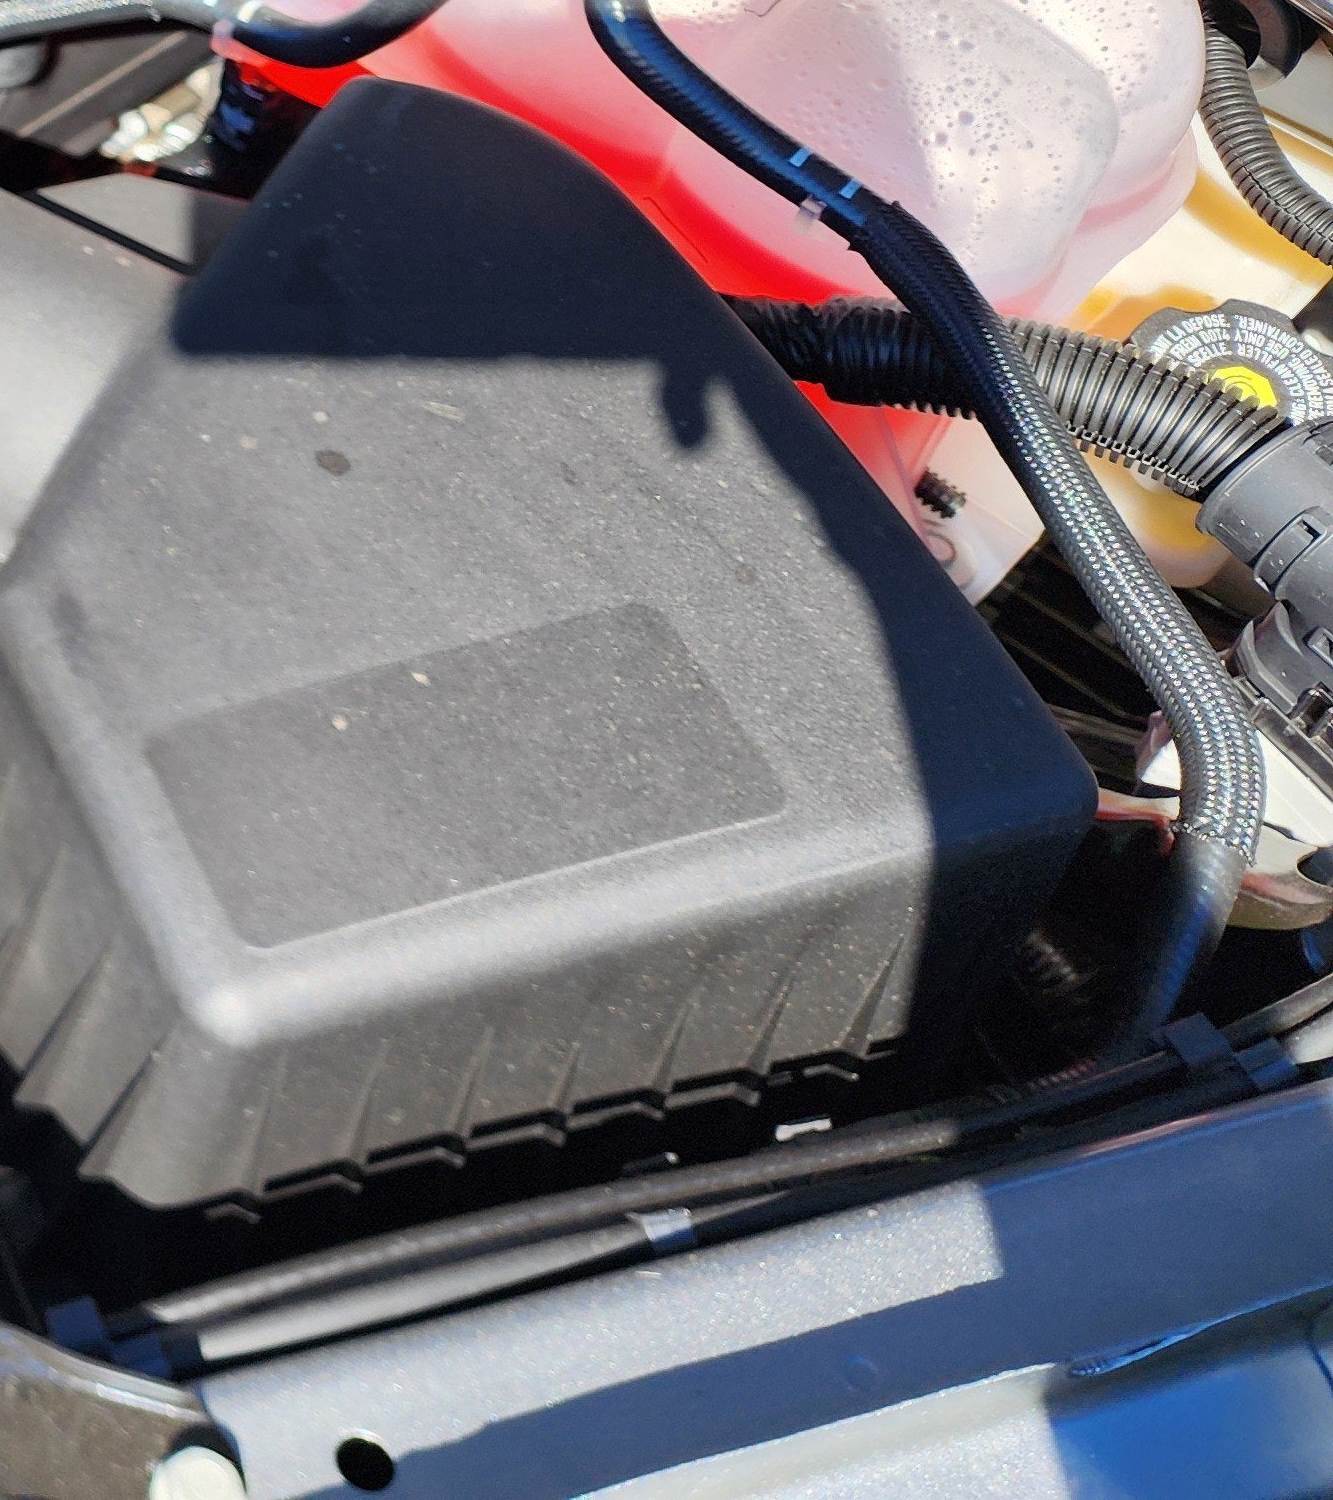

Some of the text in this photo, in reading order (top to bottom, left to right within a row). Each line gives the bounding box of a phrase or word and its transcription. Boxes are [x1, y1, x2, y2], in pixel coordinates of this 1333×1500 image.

[1165, 325, 1188, 342] LA
[1234, 329, 1266, 348] ONLY
[1237, 342, 1280, 369] FILLER
[1265, 339, 1290, 360] USE
[1274, 363, 1305, 398] CLEAN
